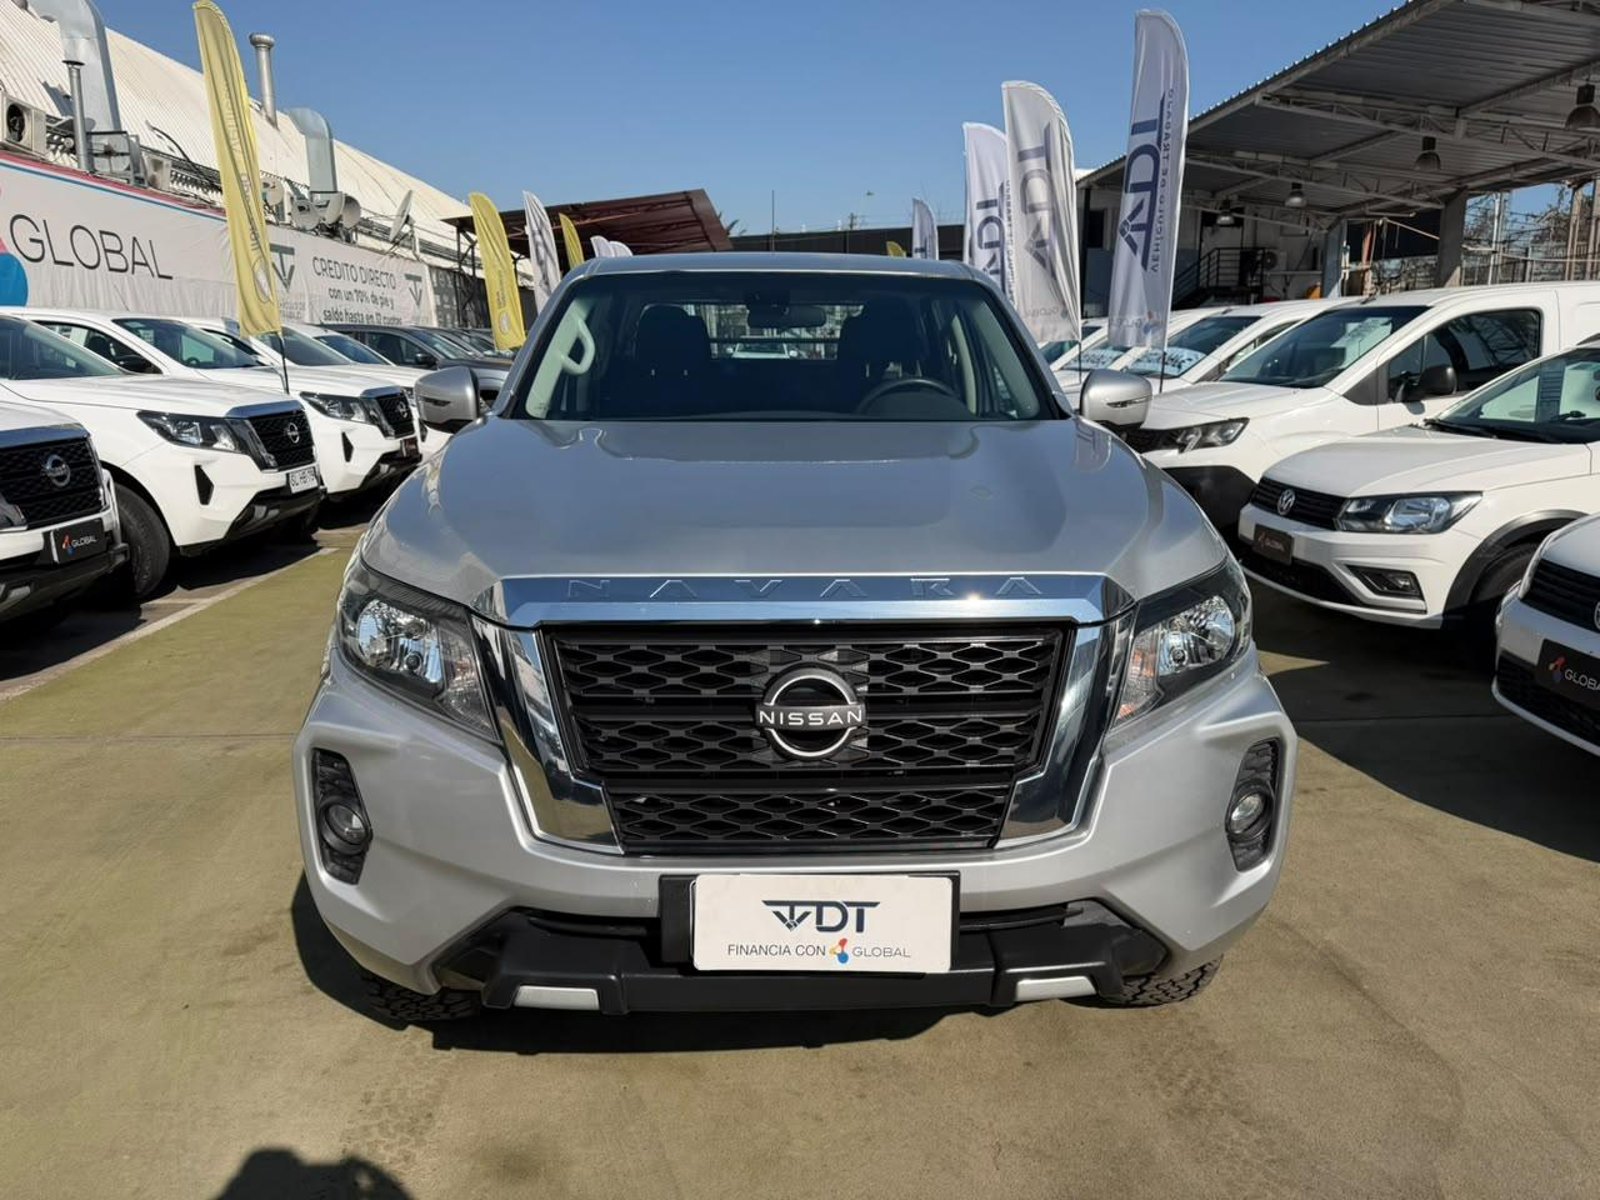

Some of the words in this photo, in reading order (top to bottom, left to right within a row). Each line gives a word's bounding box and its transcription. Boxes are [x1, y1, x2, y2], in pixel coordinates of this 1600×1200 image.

[9, 214, 173, 280] GLOBAL
[312, 256, 358, 283] CREDITO
[359, 266, 397, 290] DIRECTO
[328, 287, 342, 300] con
[323, 307, 343, 322] saldo
[345, 309, 364, 324] hasta
[71, 535, 97, 549] GLOBAL
[568, 577, 1043, 599] NAVARA
[758, 708, 864, 727] NISSAN
[727, 944, 791, 957] FINANCIA
[795, 945, 826, 957] CON
[852, 946, 911, 959] GLOBAL
